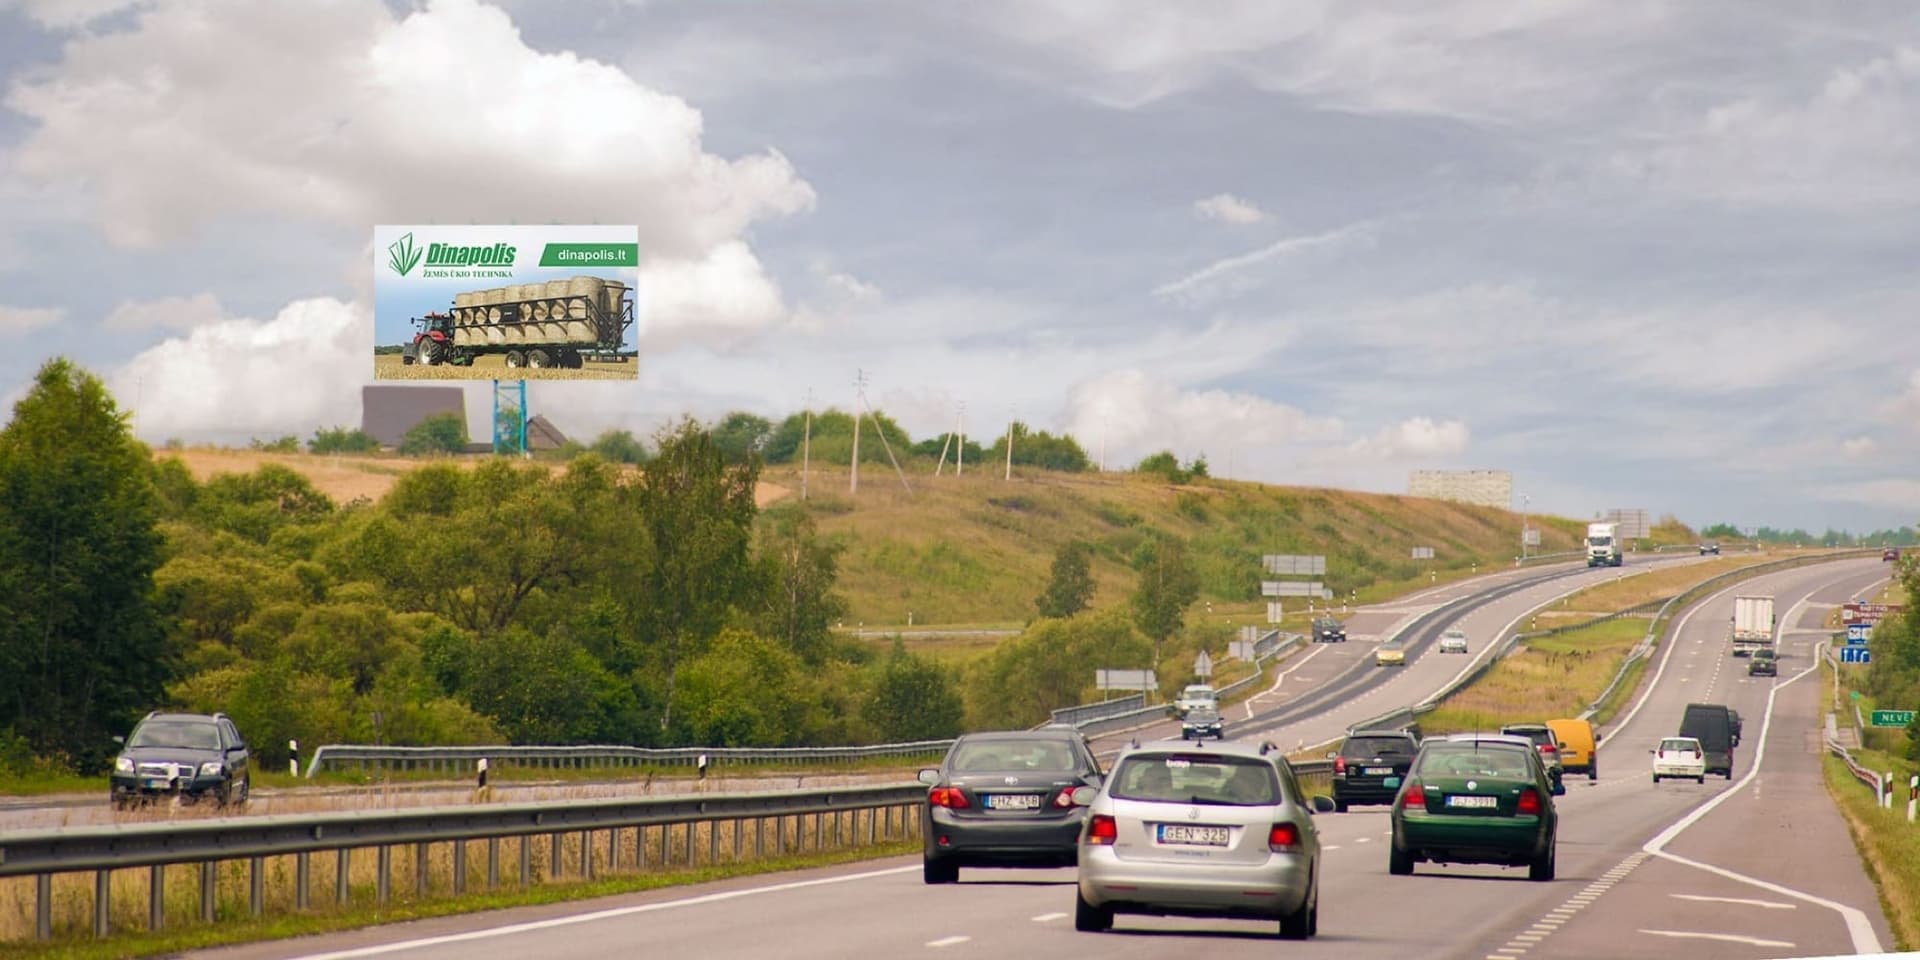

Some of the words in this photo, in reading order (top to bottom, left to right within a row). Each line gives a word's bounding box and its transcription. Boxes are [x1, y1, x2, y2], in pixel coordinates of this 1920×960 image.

[426, 243, 517, 266] Dinapolis
[558, 249, 626, 263] dinapolis.lt
[472, 270, 513, 278] TECHNIKA
[1165, 827, 1195, 841] GEN
[1202, 828, 1227, 842] 325
